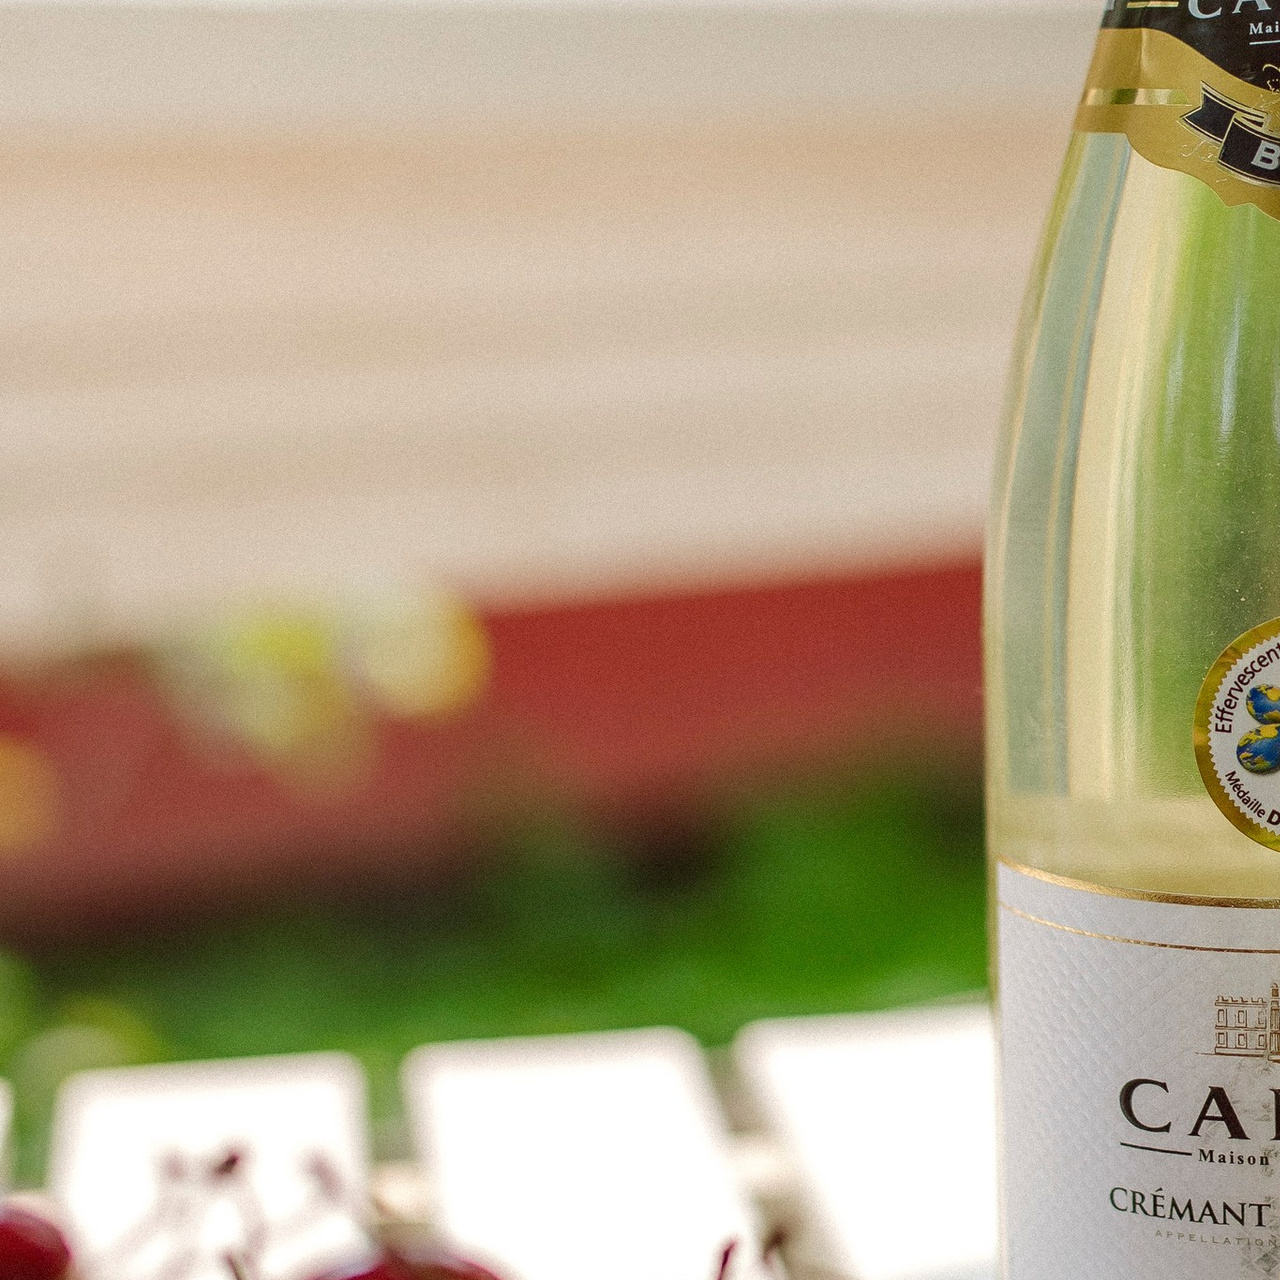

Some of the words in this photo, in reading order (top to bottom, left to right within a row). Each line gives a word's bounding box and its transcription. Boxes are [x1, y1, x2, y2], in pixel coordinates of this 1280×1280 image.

[1225, 770, 1266, 818] Médaille
[1198, 1148, 1270, 1166] Maison
[1109, 1187, 1271, 1227] CRÉMANT
[1155, 1230, 1277, 1247] APPELLATION
